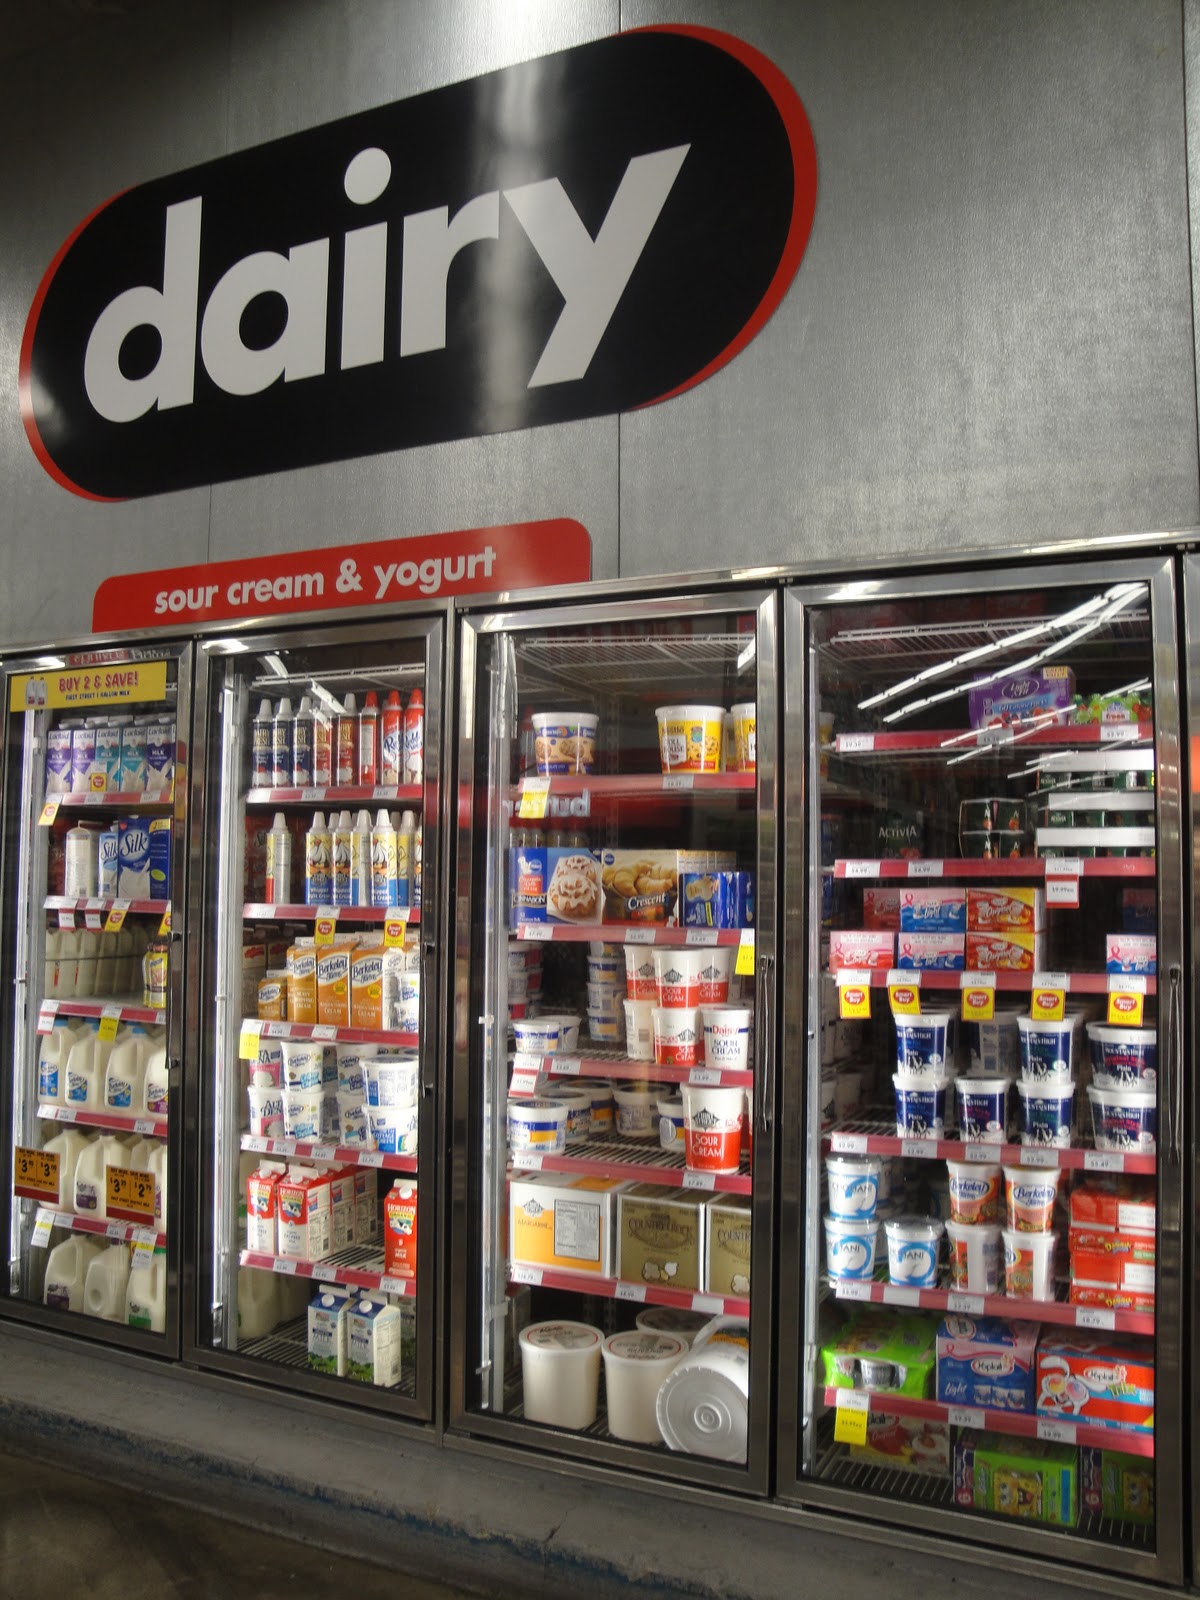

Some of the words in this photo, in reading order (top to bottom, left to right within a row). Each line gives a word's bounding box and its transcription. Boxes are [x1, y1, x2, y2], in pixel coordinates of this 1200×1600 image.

[84, 143, 692, 424] dairy
[154, 585, 218, 614] sour
[227, 571, 324, 606] cream
[335, 559, 363, 593] &
[374, 546, 496, 599] yogurt
[59, 677, 80, 693] BUY
[84, 676, 90, 690] 2
[94, 675, 101, 689] &
[105, 671, 139, 688] SAVE!
[120, 831, 148, 857] Silk
[628, 892, 666, 911] Crescent
[319, 957, 347, 974] Berkeley
[353, 959, 382, 977] Berkeley
[663, 993, 684, 1001] CREAM
[712, 1025, 738, 1035] Daisy
[712, 1047, 740, 1055] CREAM
[1032, 1121, 1048, 1129] Plain
[1113, 1127, 1128, 1135] Plain
[695, 1134, 718, 1147] SOUR
[692, 1146, 723, 1158] CREAM
[280, 1187, 304, 1197] HORIZON
[952, 1179, 985, 1193] Berkeley
[1018, 1187, 1054, 1200] Berkeley
[387, 1203, 416, 1214] HORIZON
[944, 1382, 967, 1395] Light
[1107, 1381, 1136, 1398] Trix
